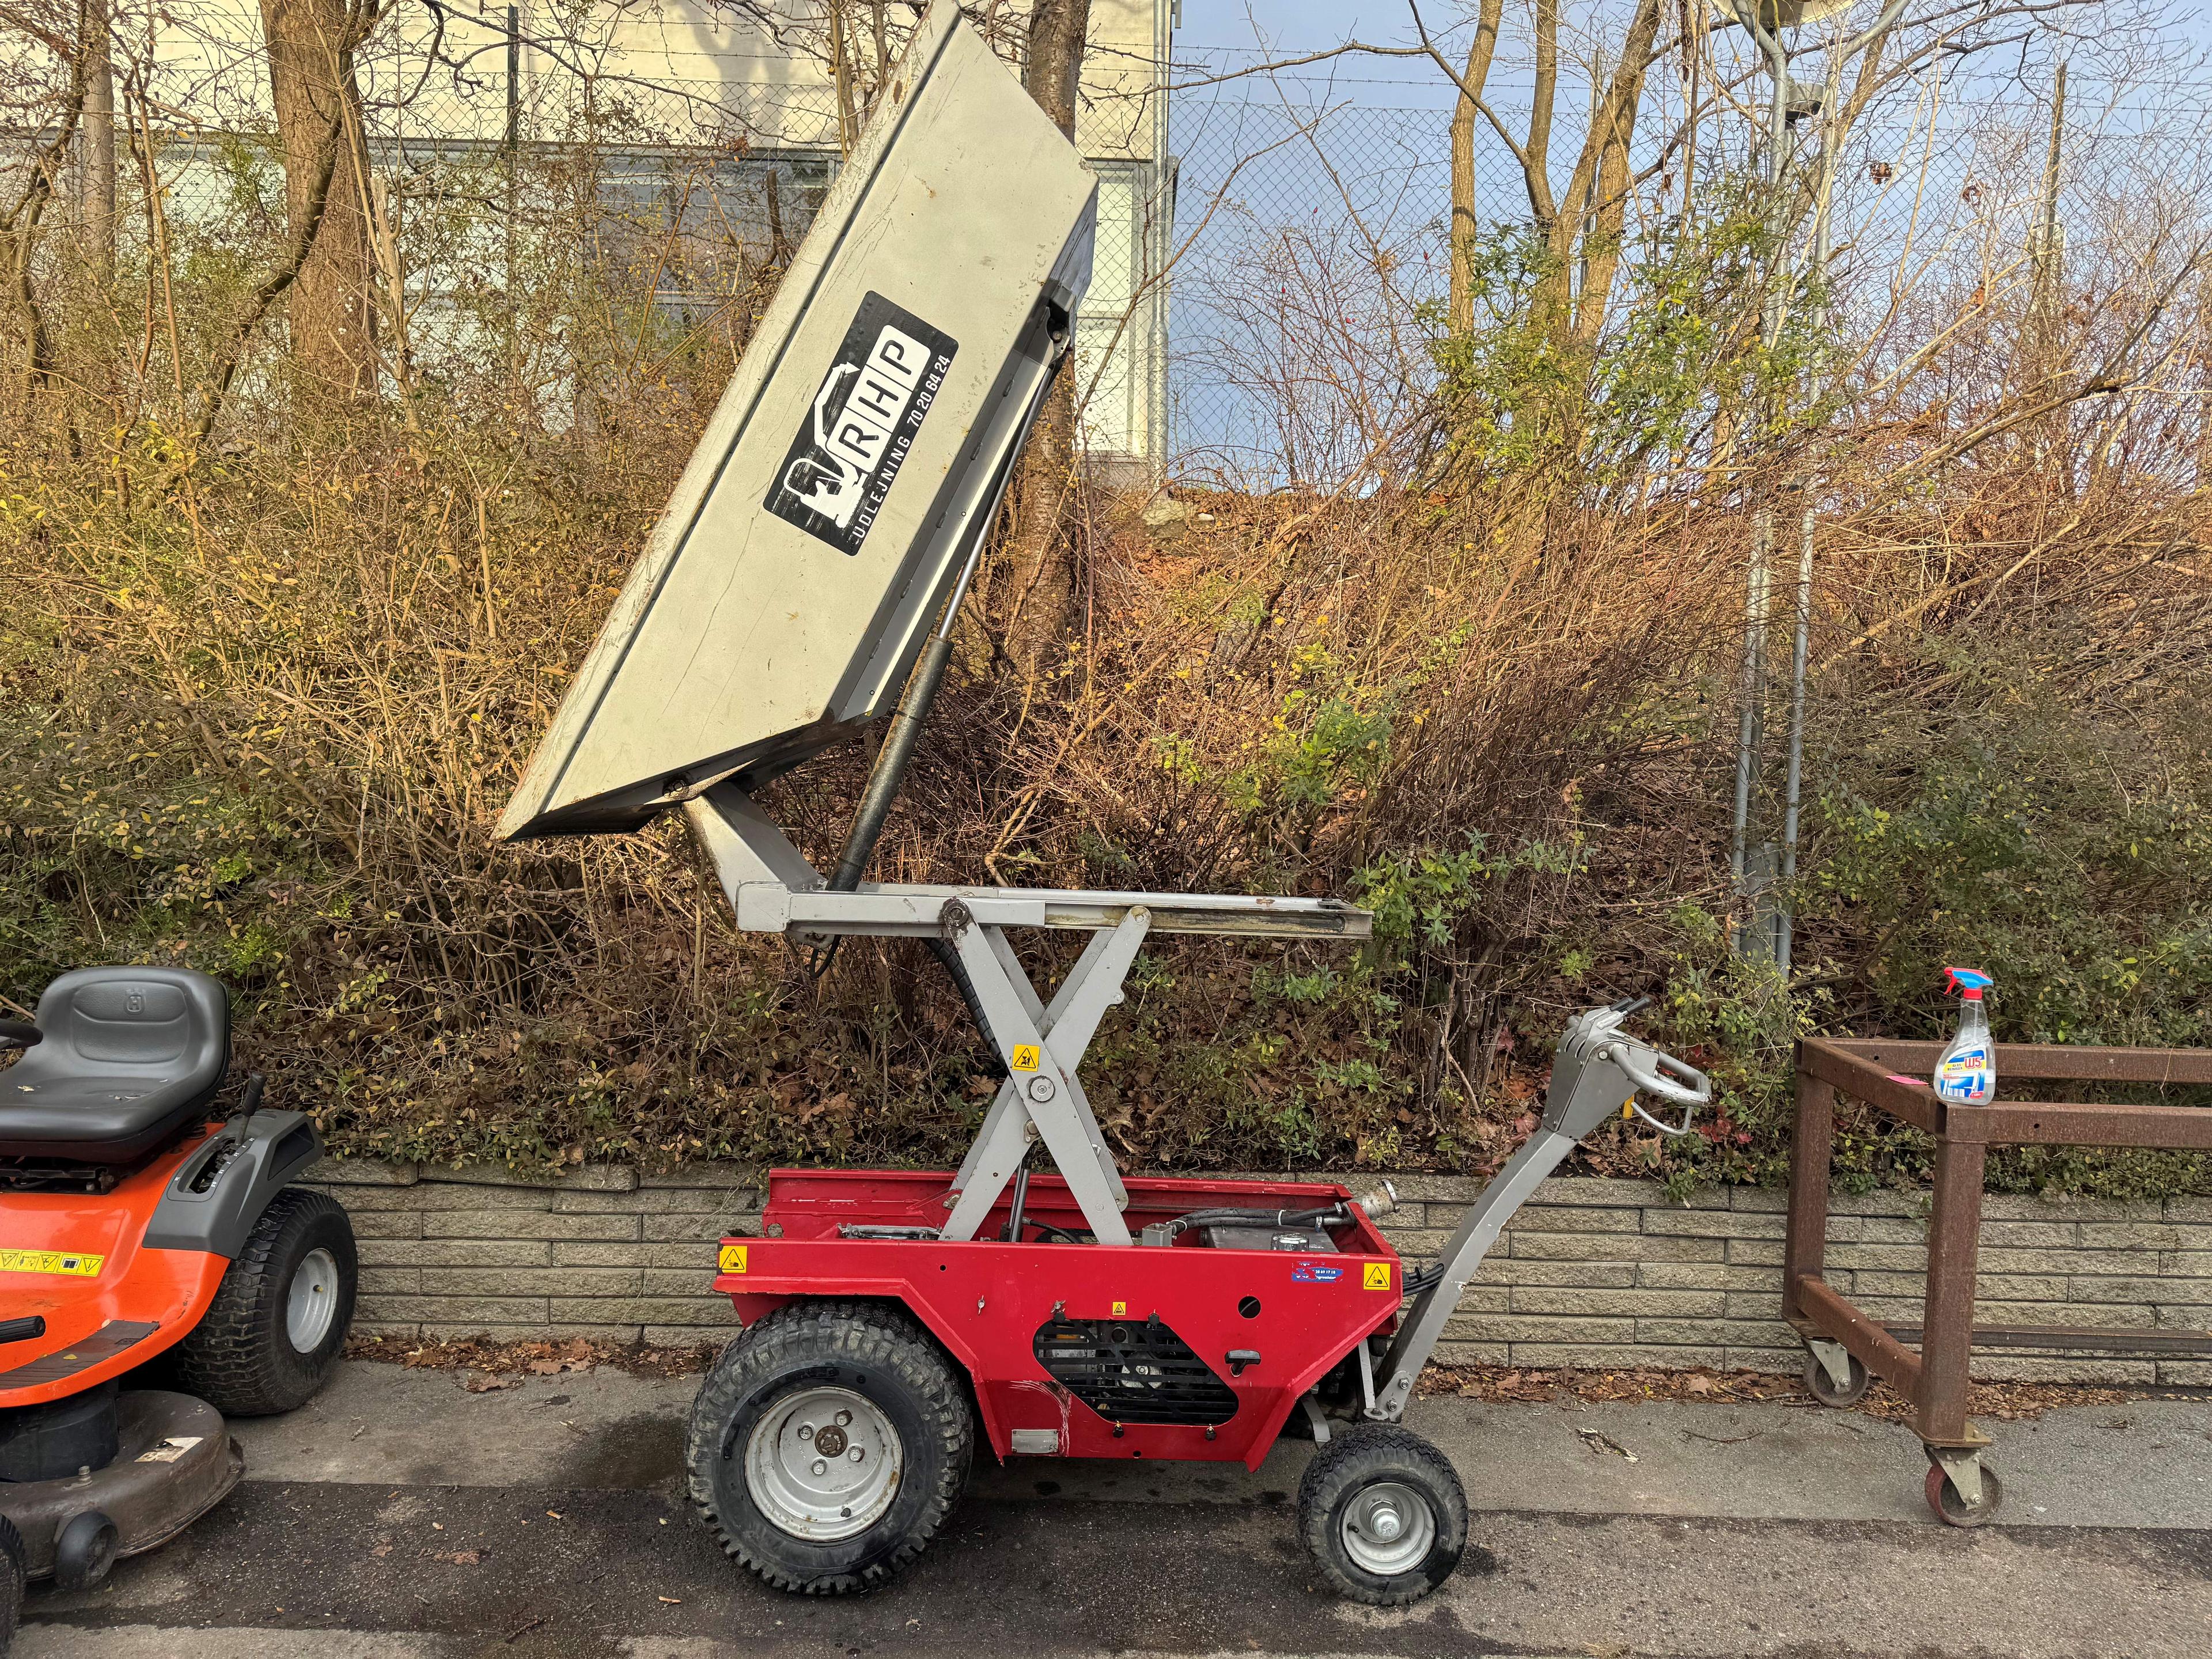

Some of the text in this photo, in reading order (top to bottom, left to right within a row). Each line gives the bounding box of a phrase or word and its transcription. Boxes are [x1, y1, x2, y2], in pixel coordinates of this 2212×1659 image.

[839, 340, 912, 459] RHP
[853, 355, 950, 539] UDLEJNING 70 20 64 24
[1965, 1057, 1982, 1069] W5
